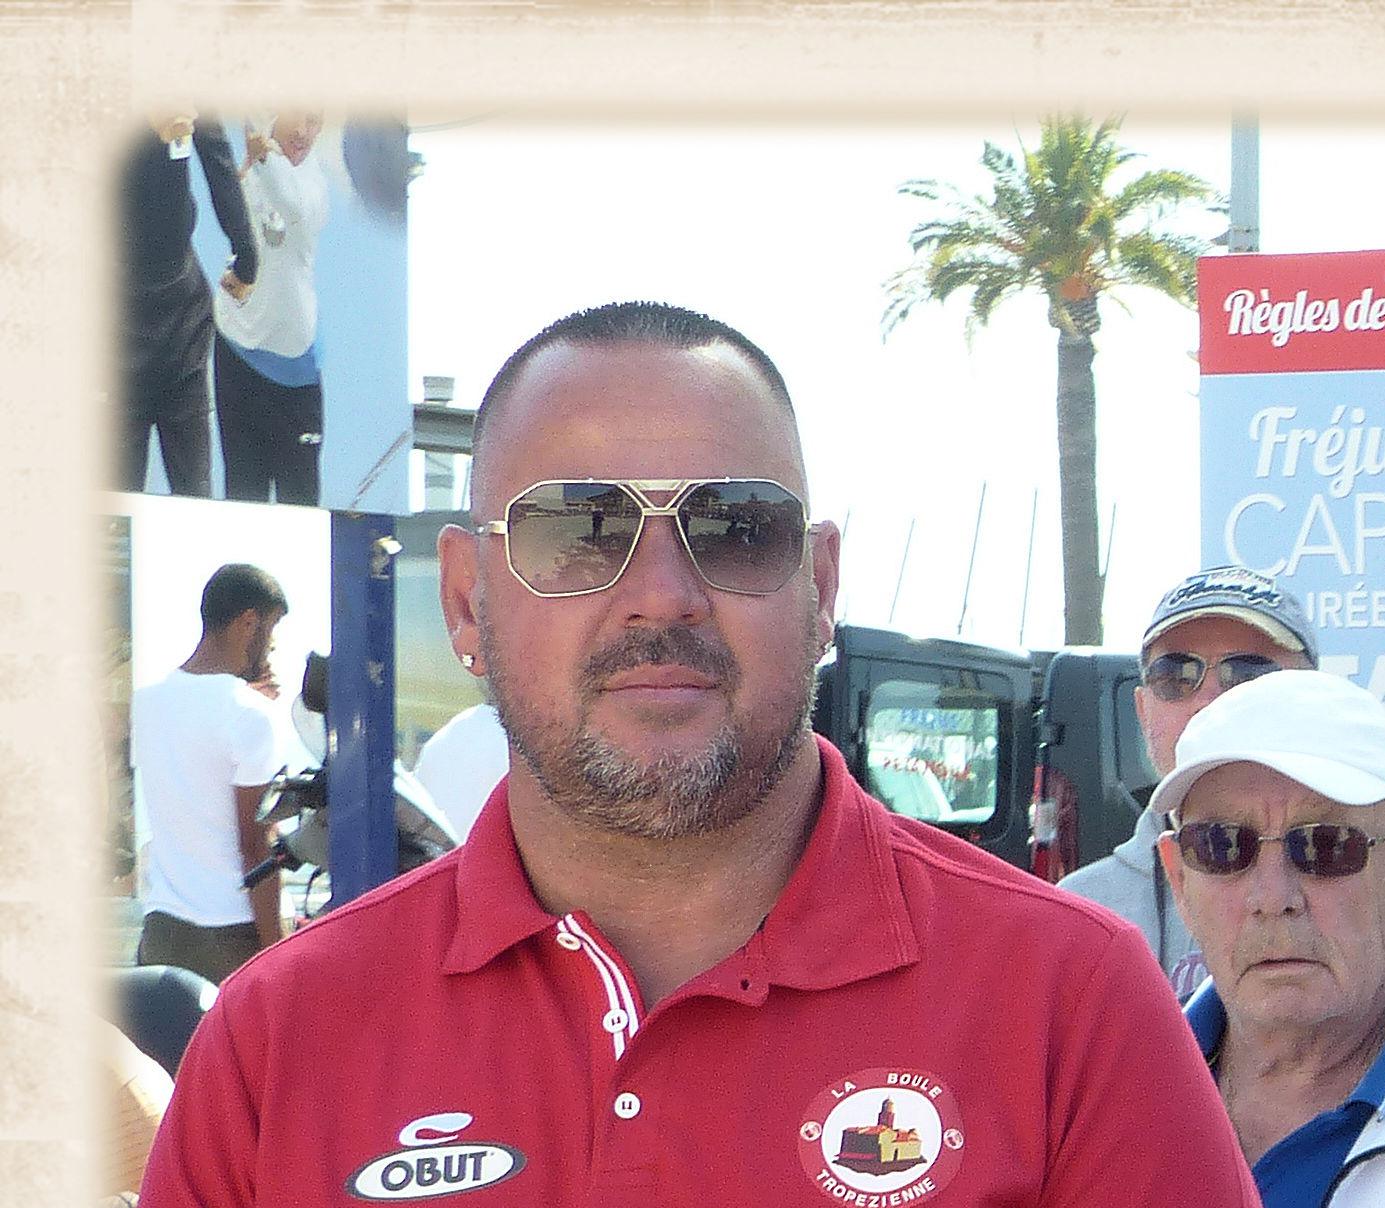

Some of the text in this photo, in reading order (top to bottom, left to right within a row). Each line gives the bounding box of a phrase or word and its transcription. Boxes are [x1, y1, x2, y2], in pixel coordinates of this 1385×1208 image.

[1224, 286, 1340, 348] Règles
[831, 1072, 943, 1099] LA BOULE
[381, 1150, 488, 1191] OBUT
[816, 1168, 937, 1208] TROPEZIENNE
